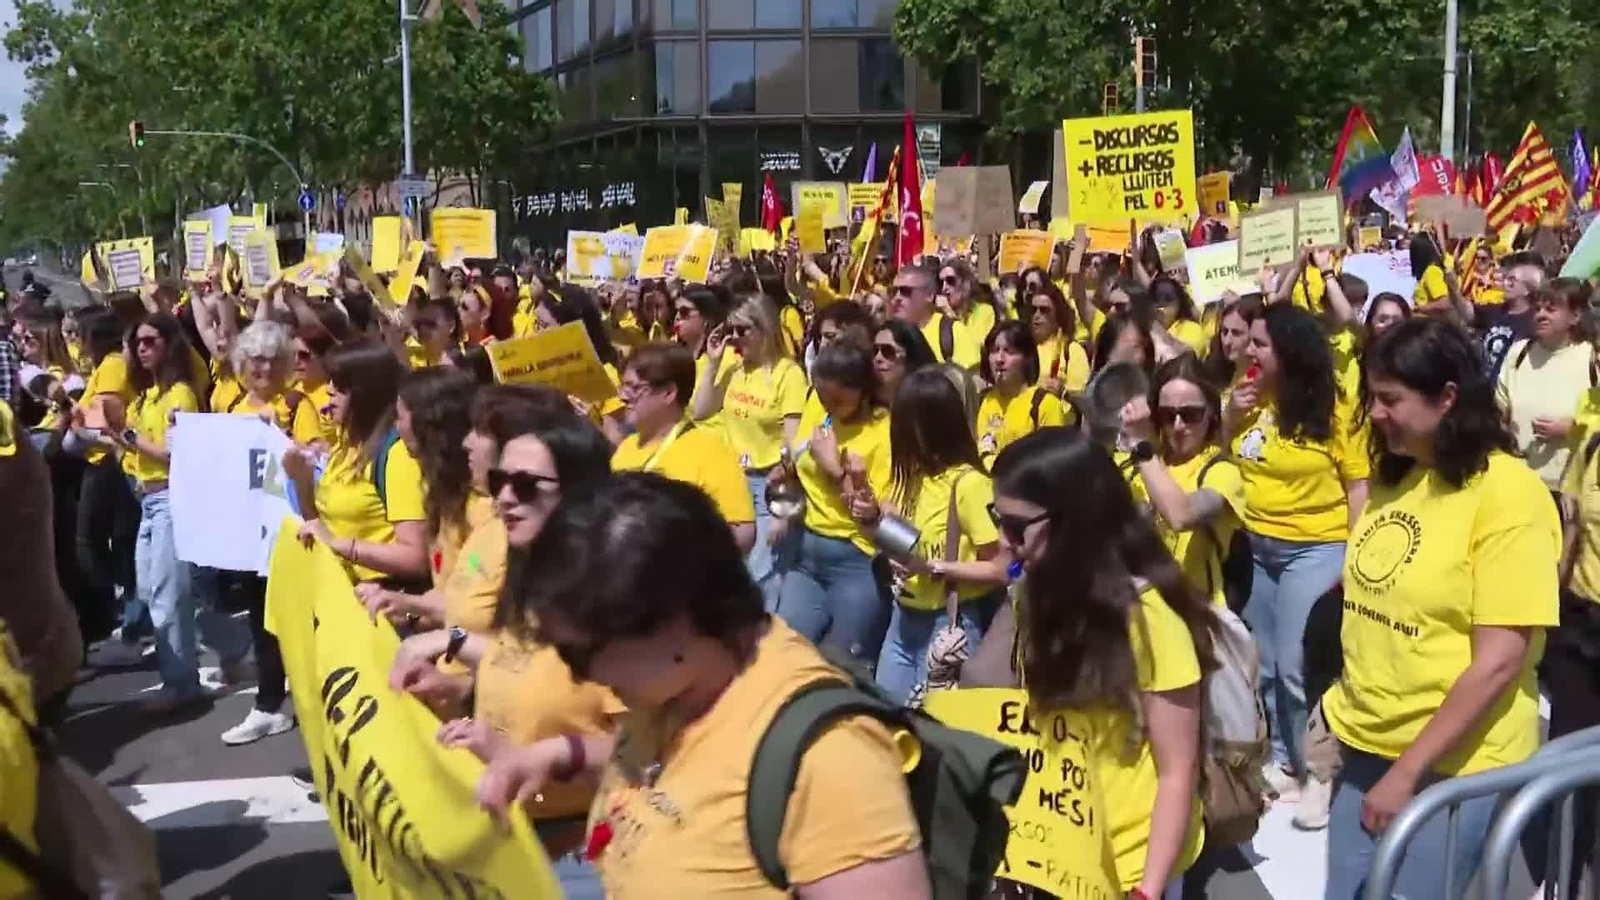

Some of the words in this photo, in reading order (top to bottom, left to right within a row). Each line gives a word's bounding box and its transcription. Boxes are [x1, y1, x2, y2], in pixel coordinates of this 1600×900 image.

[1093, 121, 1180, 152] DISCURSOS
[1095, 149, 1175, 178] RECURSOS
[1122, 170, 1174, 192] LLUITEM
[1123, 192, 1149, 212] PEL
